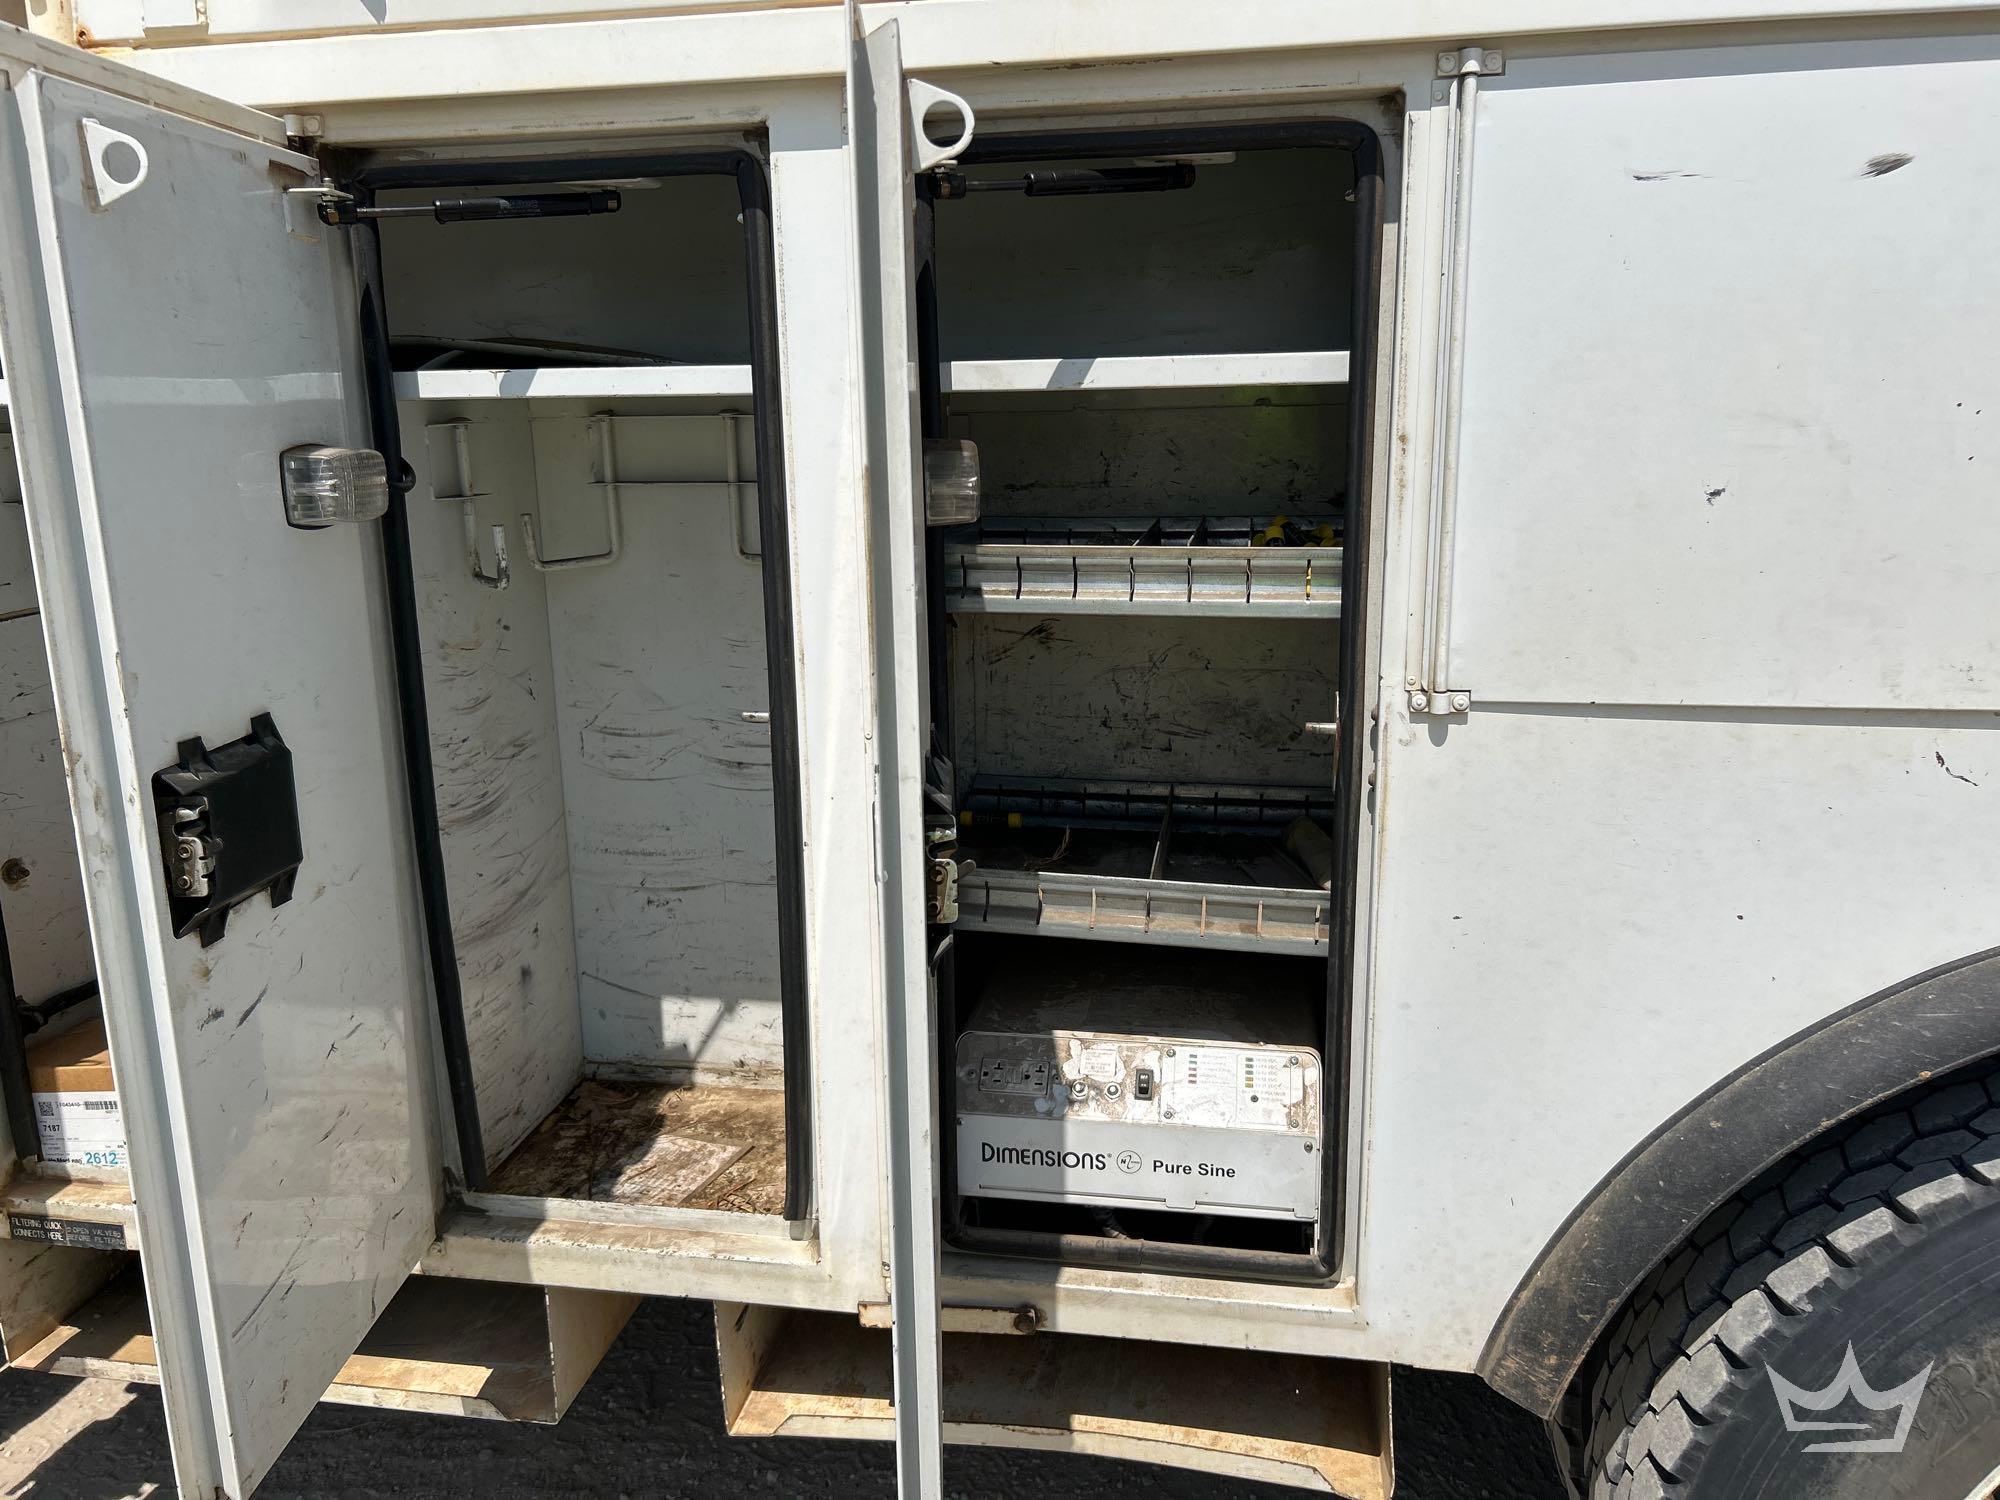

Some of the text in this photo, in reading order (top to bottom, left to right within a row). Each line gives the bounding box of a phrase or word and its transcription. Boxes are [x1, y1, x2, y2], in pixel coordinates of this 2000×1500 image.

[85, 1152, 118, 1165] 2612
[1153, 1160, 1236, 1178] Pure Sine
[11, 1217, 42, 1228] FILTERING
[43, 1220, 63, 1230] QUICK
[13, 1228, 46, 1239] CONNECTS
[47, 1230, 64, 1241] HERE
